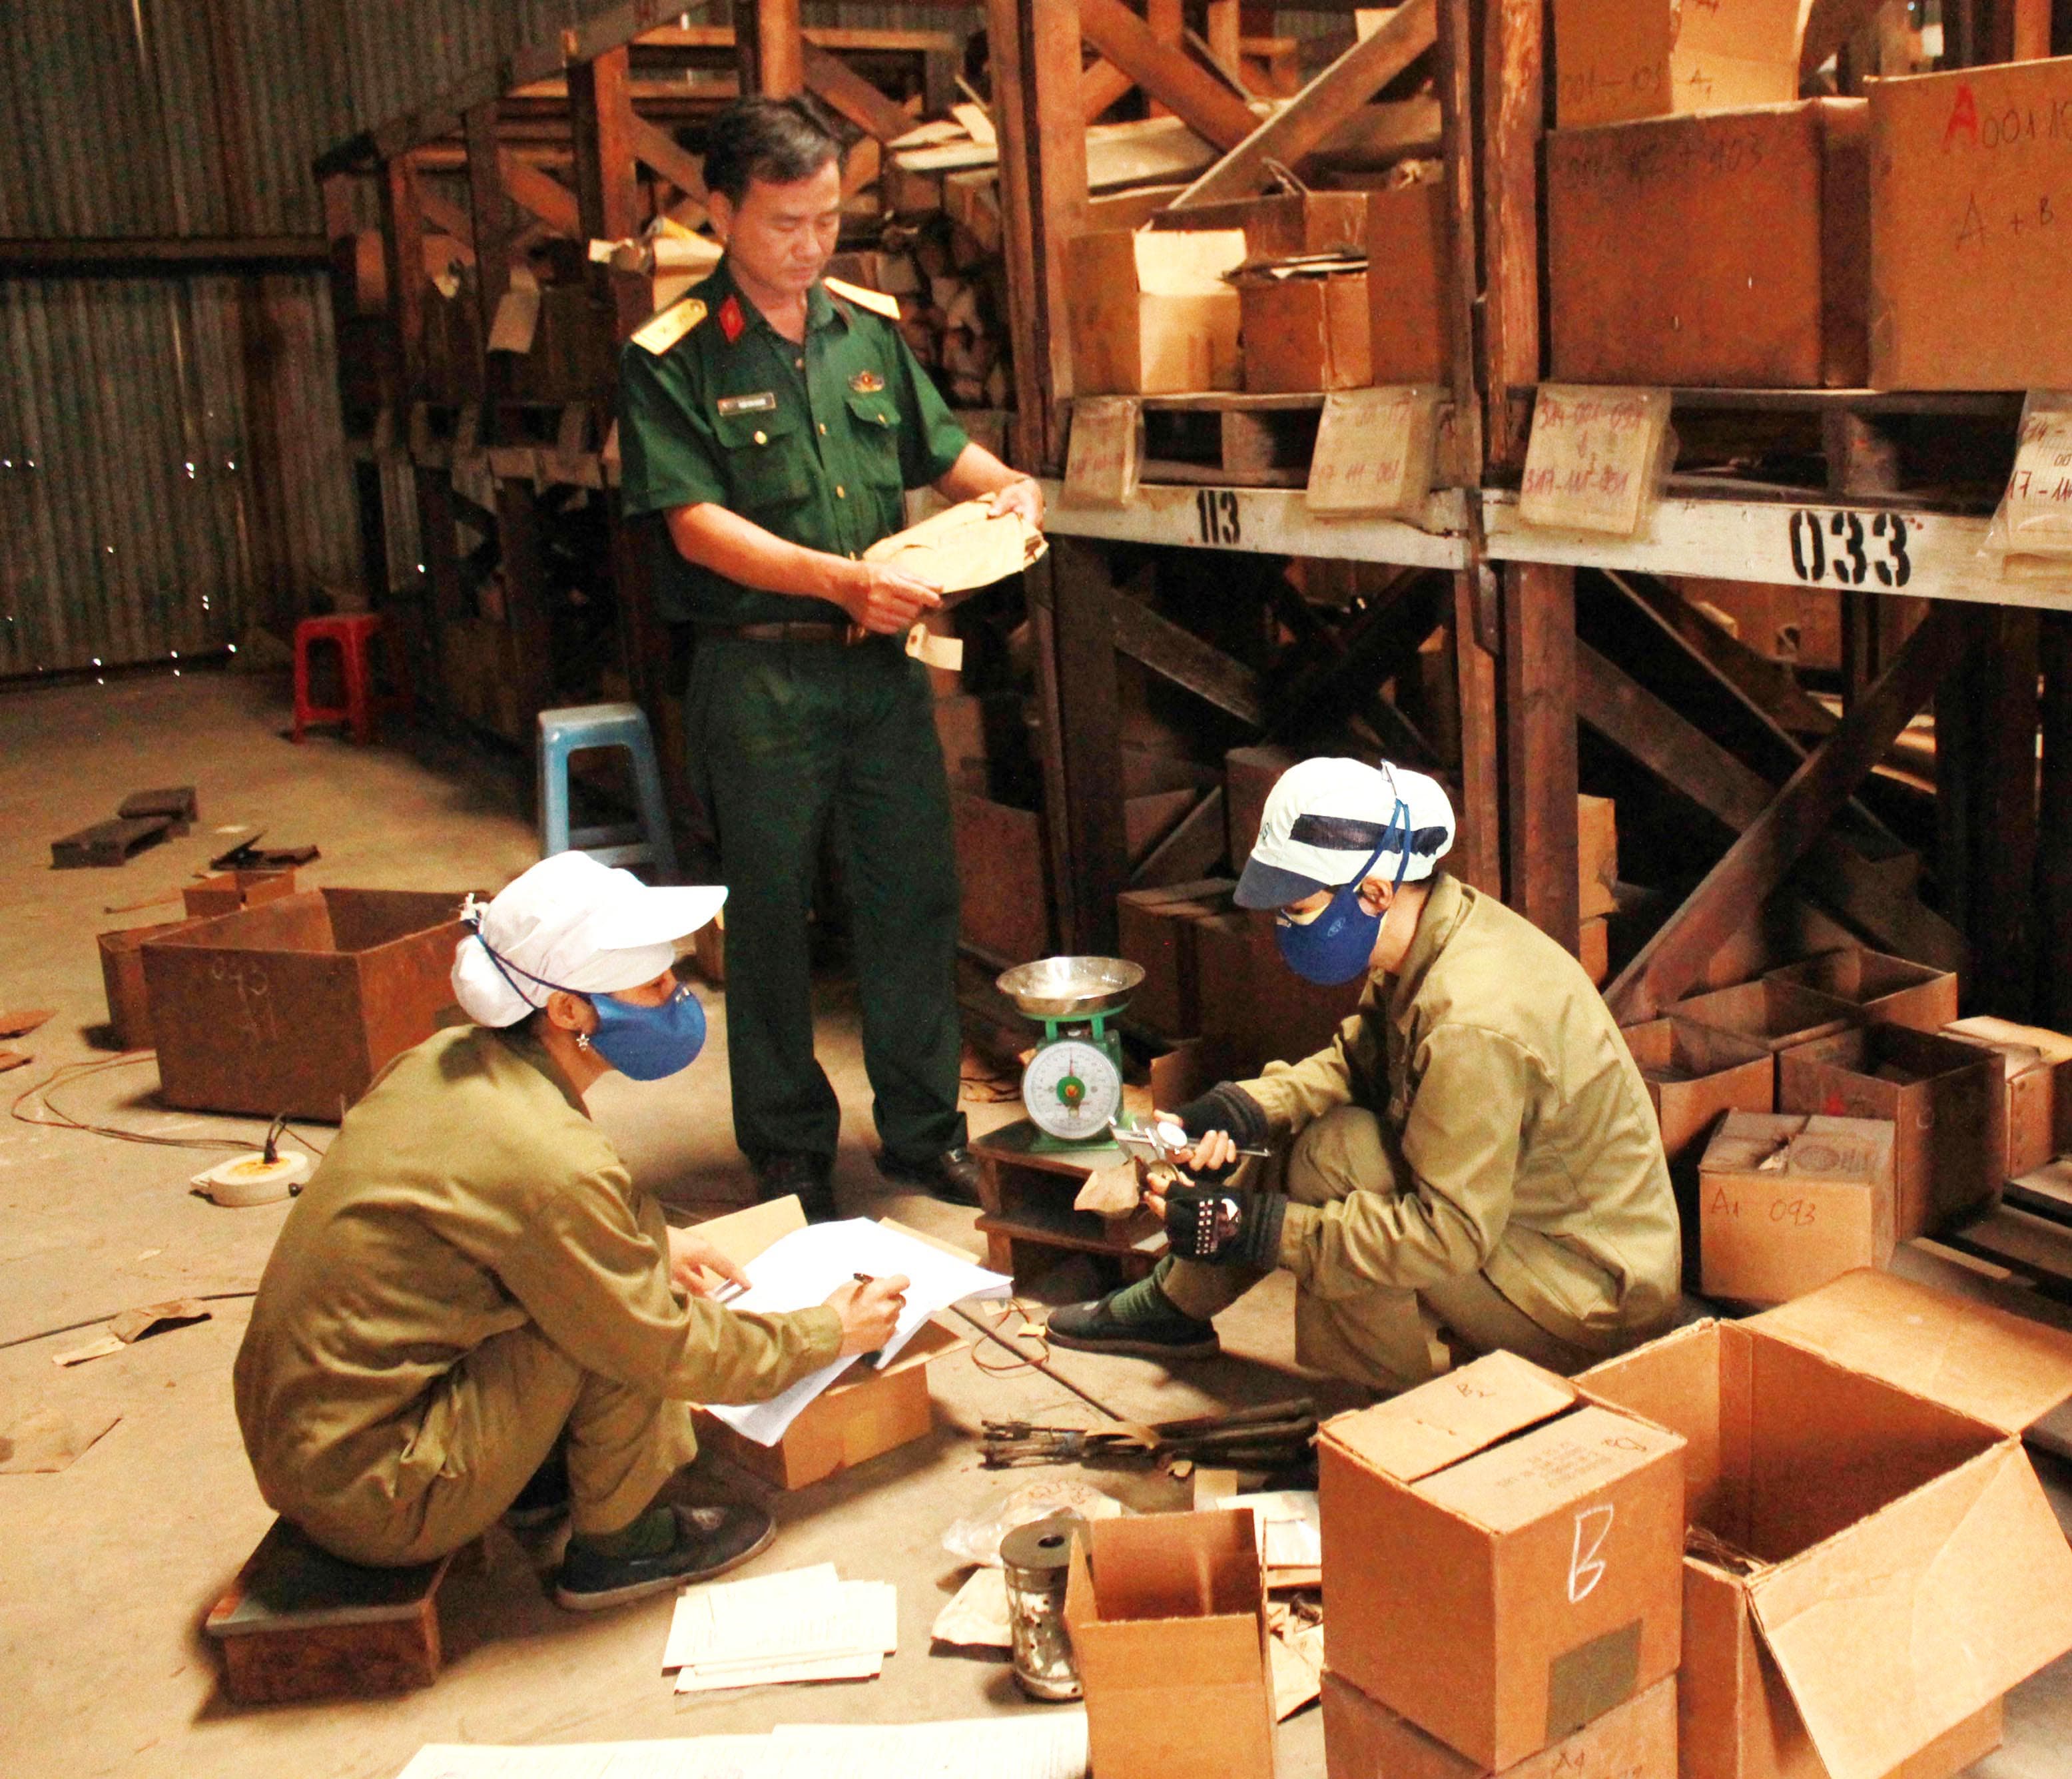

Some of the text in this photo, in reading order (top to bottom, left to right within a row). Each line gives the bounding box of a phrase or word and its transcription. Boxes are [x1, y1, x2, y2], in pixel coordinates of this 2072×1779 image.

[1197, 490, 1241, 543] 113
[1789, 510, 1911, 587] 033
[1568, 1503, 1614, 1603] B
